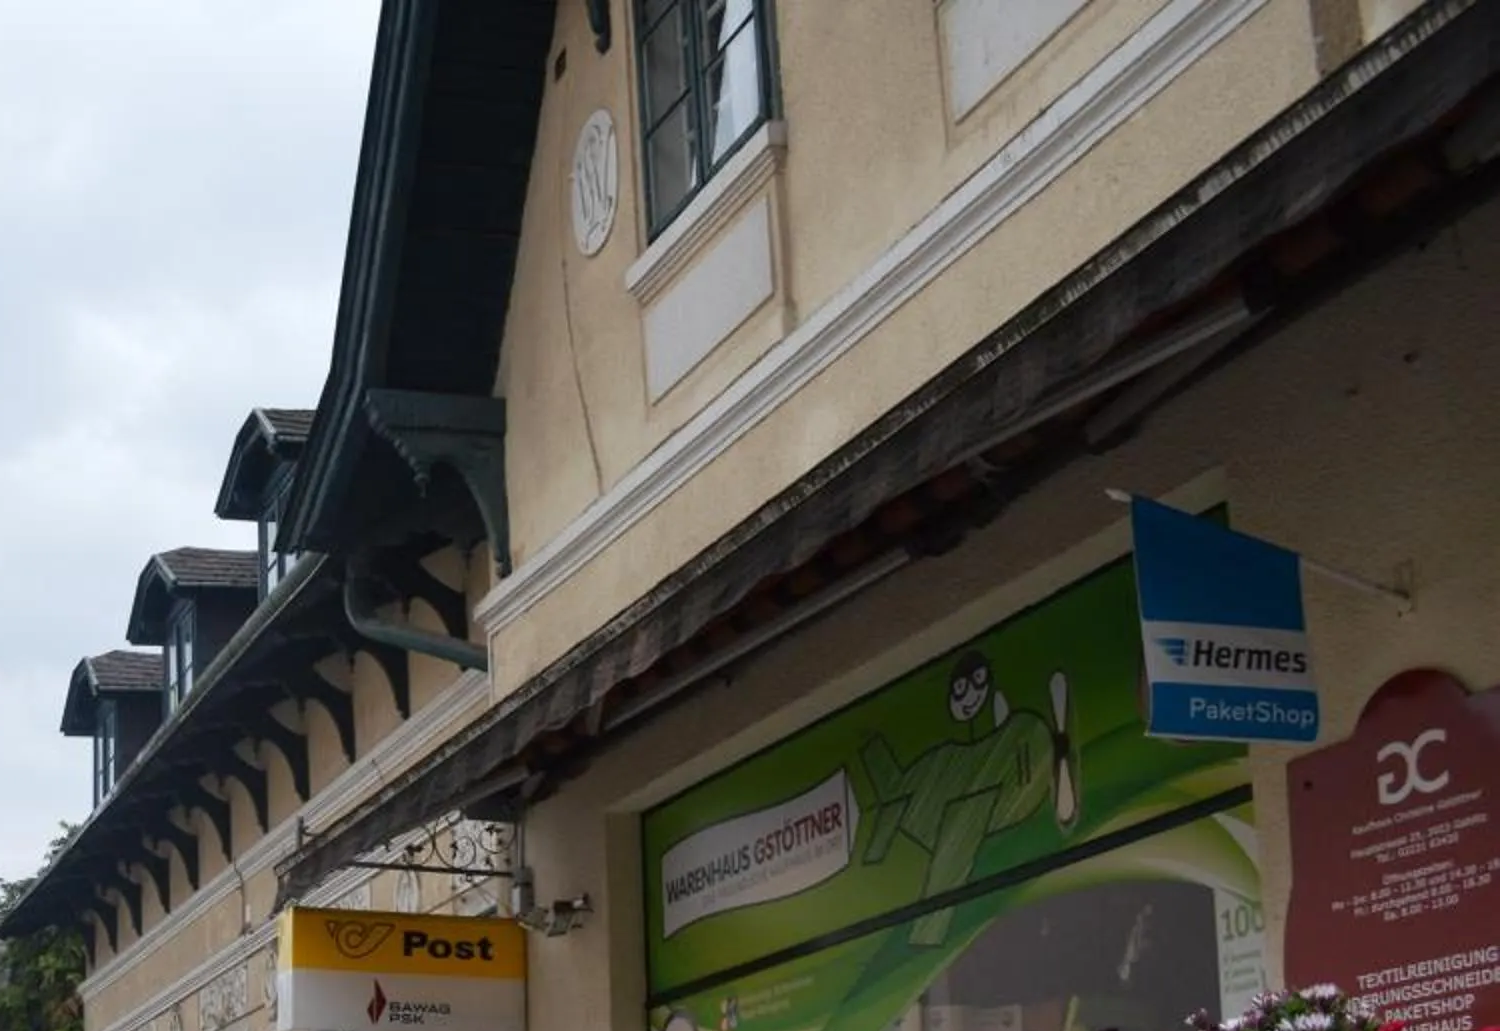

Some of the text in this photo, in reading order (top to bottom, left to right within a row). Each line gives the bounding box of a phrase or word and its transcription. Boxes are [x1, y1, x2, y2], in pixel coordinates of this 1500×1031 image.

[1193, 639, 1307, 673] Hermes
[1189, 697, 1315, 729] PaketShop
[665, 846, 750, 904] WARENHAUS
[753, 801, 842, 865] GSTÖTTNER
[403, 931, 494, 961] Post
[1357, 945, 1498, 990] TEXTILREINIGUNG
[1347, 966, 1500, 1016] DERUNGSSCHNEIDE
[388, 1000, 451, 1016] BAWAG
[389, 1013, 425, 1025] PSK
[1384, 993, 1475, 1024] PAKETSHOP
